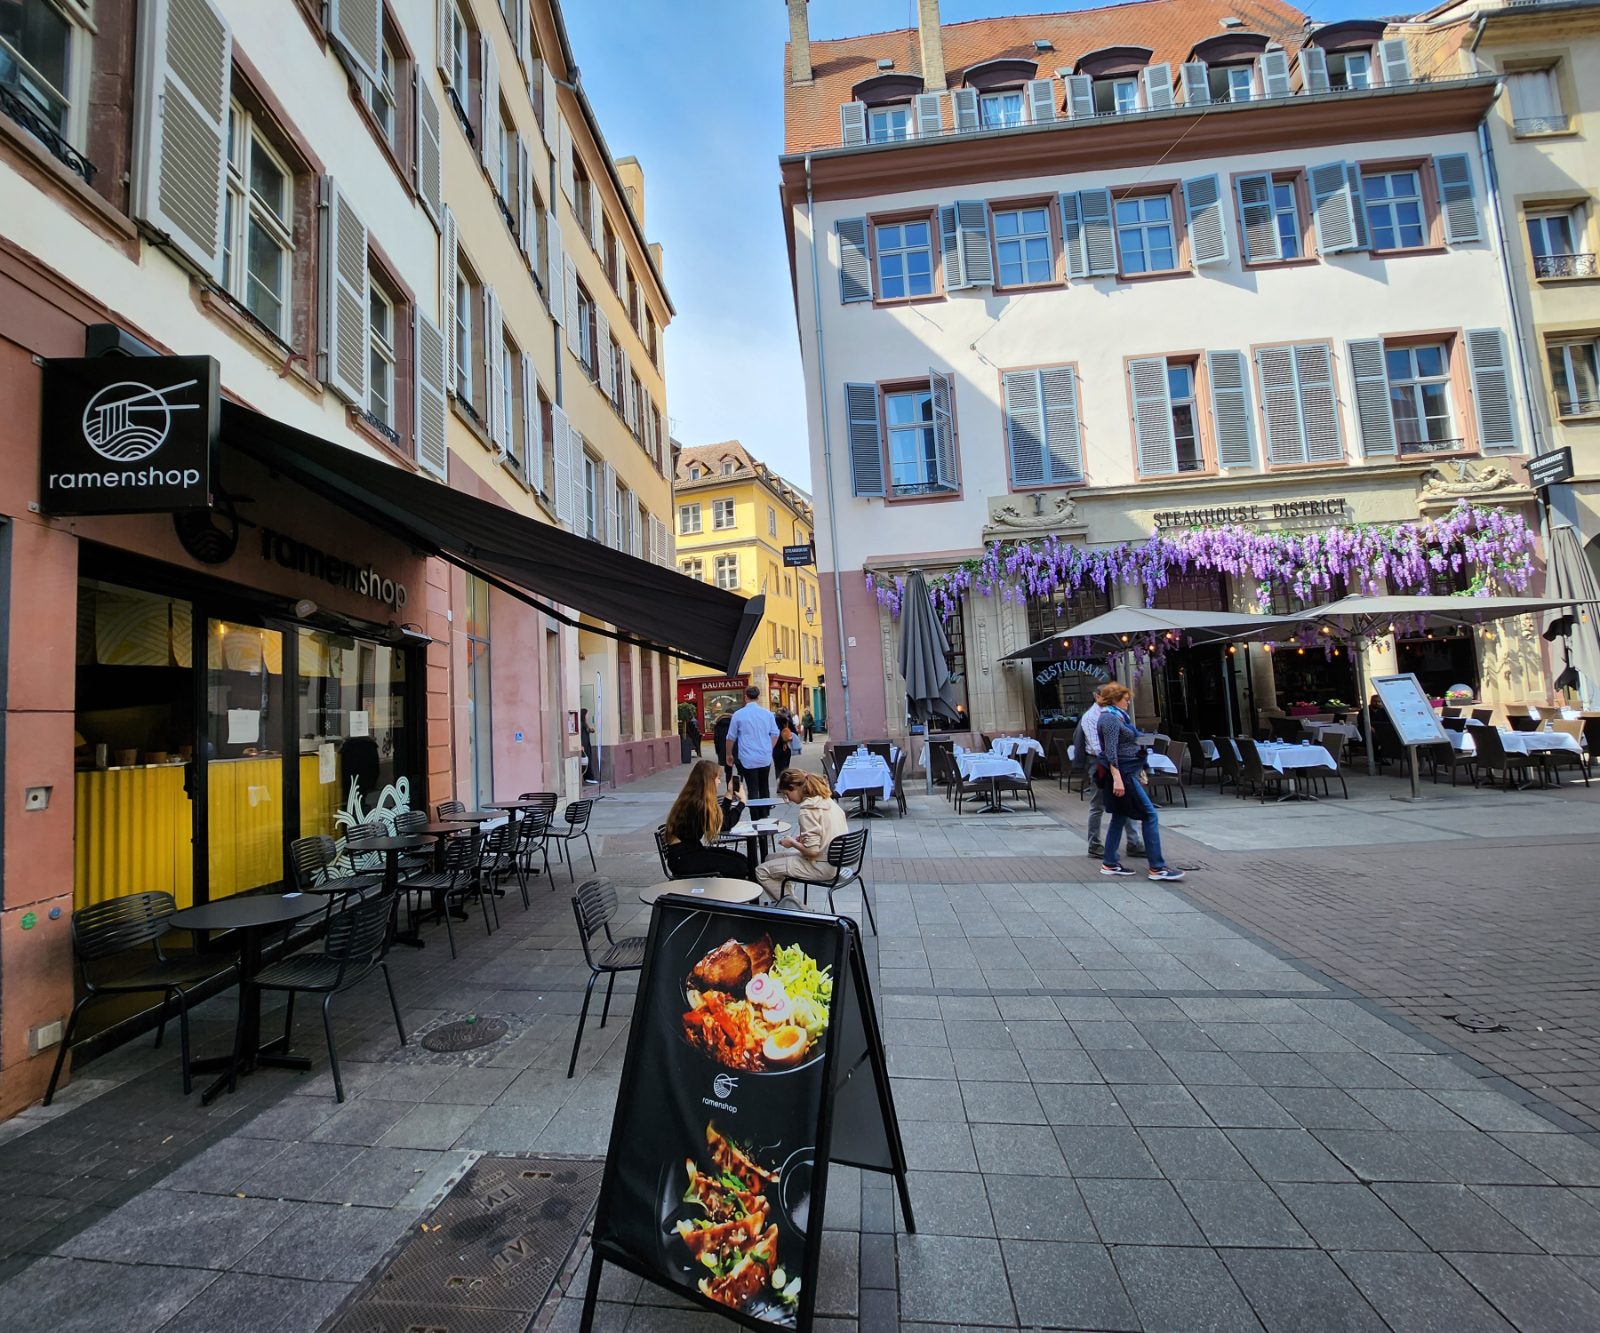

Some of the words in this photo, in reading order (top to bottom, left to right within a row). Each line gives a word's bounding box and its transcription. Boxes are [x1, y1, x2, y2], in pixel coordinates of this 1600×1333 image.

[49, 466, 200, 489] ramenshop
[1153, 505, 1260, 528] STEAKHOUSE
[1272, 498, 1346, 518] DISTRICT
[260, 527, 408, 613] ramenshop
[1036, 659, 1109, 685] RESTAURANT
[701, 680, 744, 689] BAUMANN
[702, 1096, 738, 1114] ramenshop
